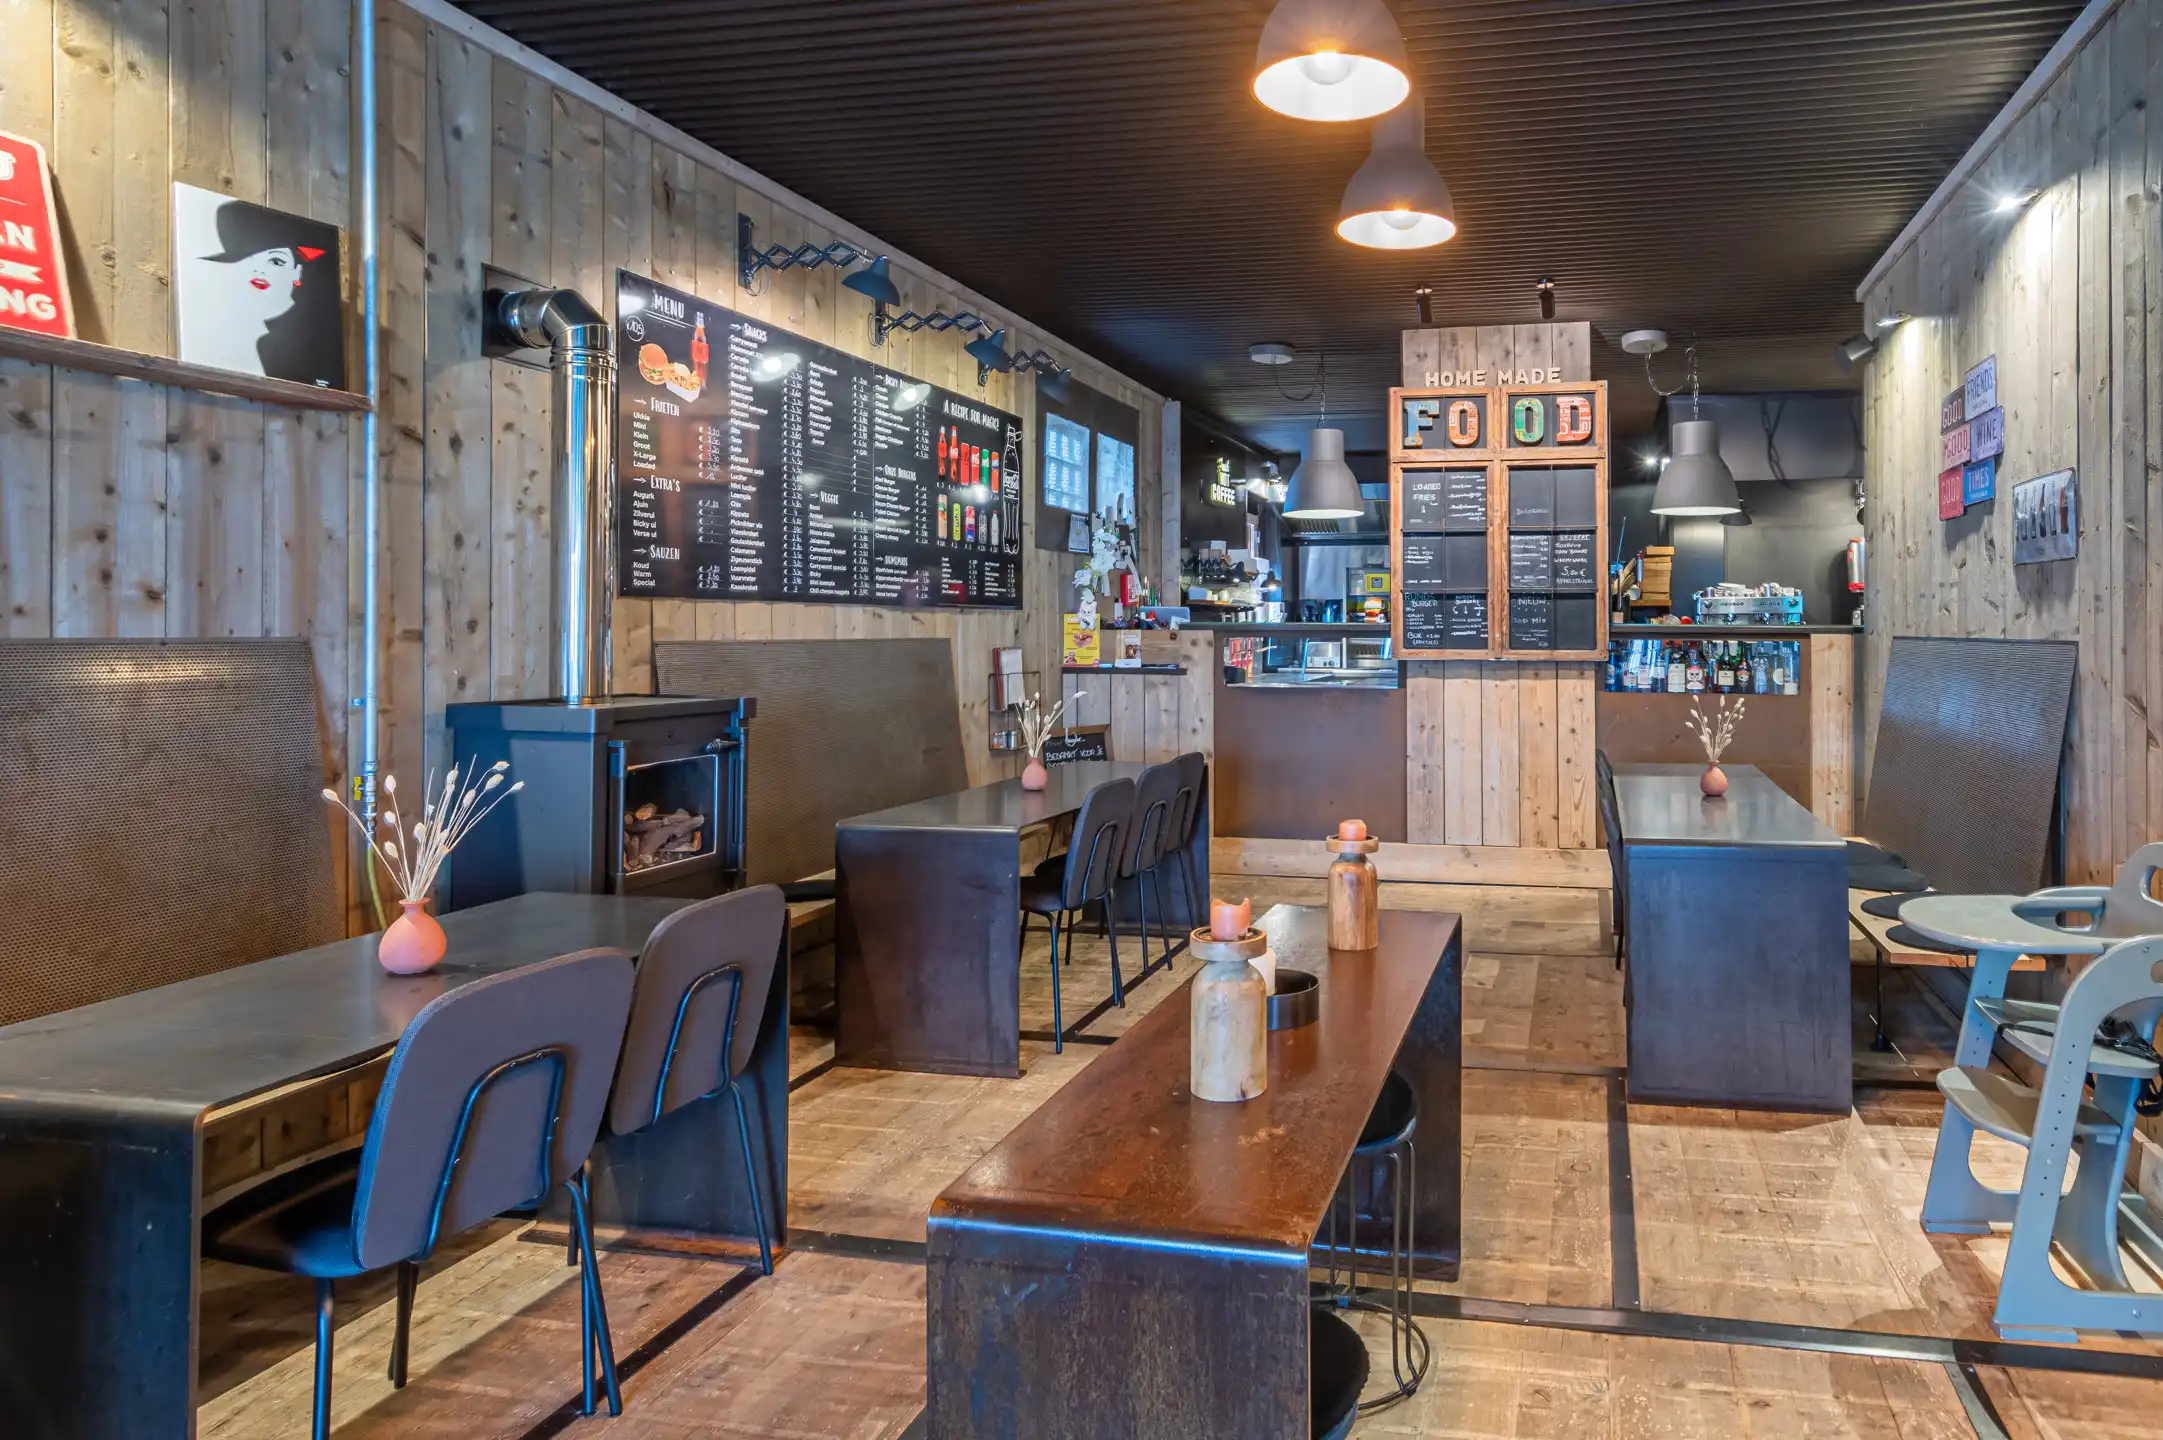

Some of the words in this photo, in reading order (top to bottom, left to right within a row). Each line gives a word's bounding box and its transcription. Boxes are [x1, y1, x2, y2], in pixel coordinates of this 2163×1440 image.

[654, 293, 685, 318] MENU
[1425, 370, 1487, 388] HOME
[1497, 367, 1562, 385] MADE
[1966, 367, 1993, 405] FRIENDS
[651, 397, 679, 416] FRIETEN
[633, 412, 650, 421] Ukkie
[944, 399, 949, 414] A
[951, 402, 969, 420] RECIPE
[971, 409, 981, 424] FOR
[982, 414, 1000, 432] MAGIC!
[1942, 399, 1963, 428] GOOD
[633, 421, 646, 430] Mini
[633, 431, 649, 440] Klein
[1976, 418, 1997, 449] WINE
[633, 441, 651, 450] Groot
[633, 450, 656, 461] X-Large
[633, 460, 656, 470] Loaded
[898, 467, 916, 481] BURGERS
[1967, 467, 1989, 493] TIMES
[651, 475, 680, 492] EXTRA'S
[1412, 483, 1441, 491] LOADED
[633, 491, 655, 500] Augurk
[1210, 483, 1236, 506] COFFEE
[1941, 476, 1960, 505] GOOD
[820, 491, 839, 505] VEGGIE
[1413, 493, 1436, 501] FRIES
[633, 500, 649, 508] Ajuin
[633, 520, 649, 528] Bicky
[633, 529, 650, 537] Verse
[650, 545, 680, 560] SAUZEN
[633, 579, 656, 587] Special
[1405, 592, 1435, 601] RUNDS
